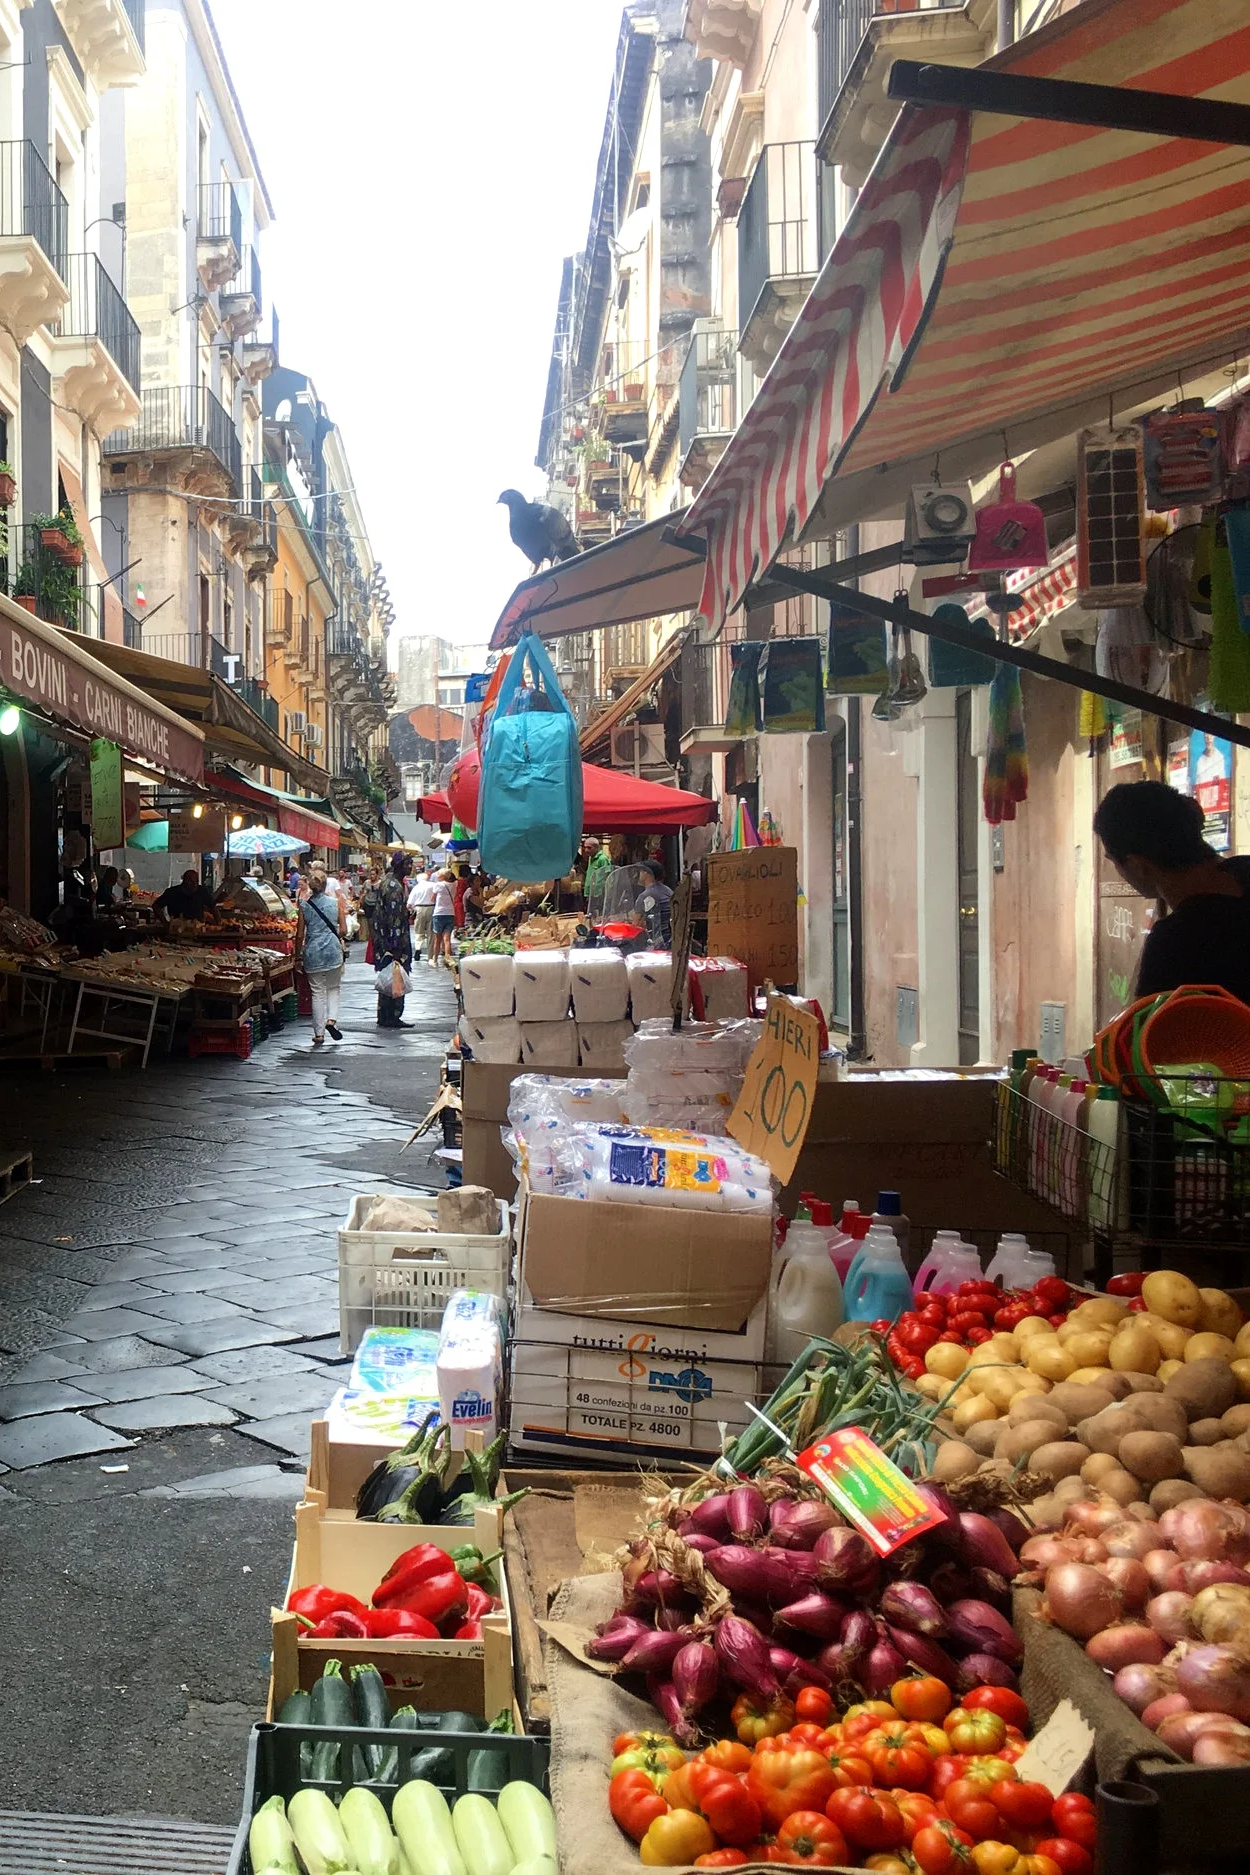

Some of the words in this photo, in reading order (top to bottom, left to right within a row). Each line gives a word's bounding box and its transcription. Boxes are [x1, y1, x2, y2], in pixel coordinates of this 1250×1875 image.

[10, 630, 68, 707] BOVINI
[84, 681, 123, 735] CARNI
[127, 704, 170, 760] BIANCHE
[452, 1398, 493, 1418] Evelin
[576, 1392, 590, 1404] 48
[591, 1396, 638, 1410] confezioni
[639, 1402, 652, 1412] da
[668, 1405, 689, 1416] 100
[581, 1414, 627, 1430] TOTALE
[649, 1422, 682, 1437] 4800
